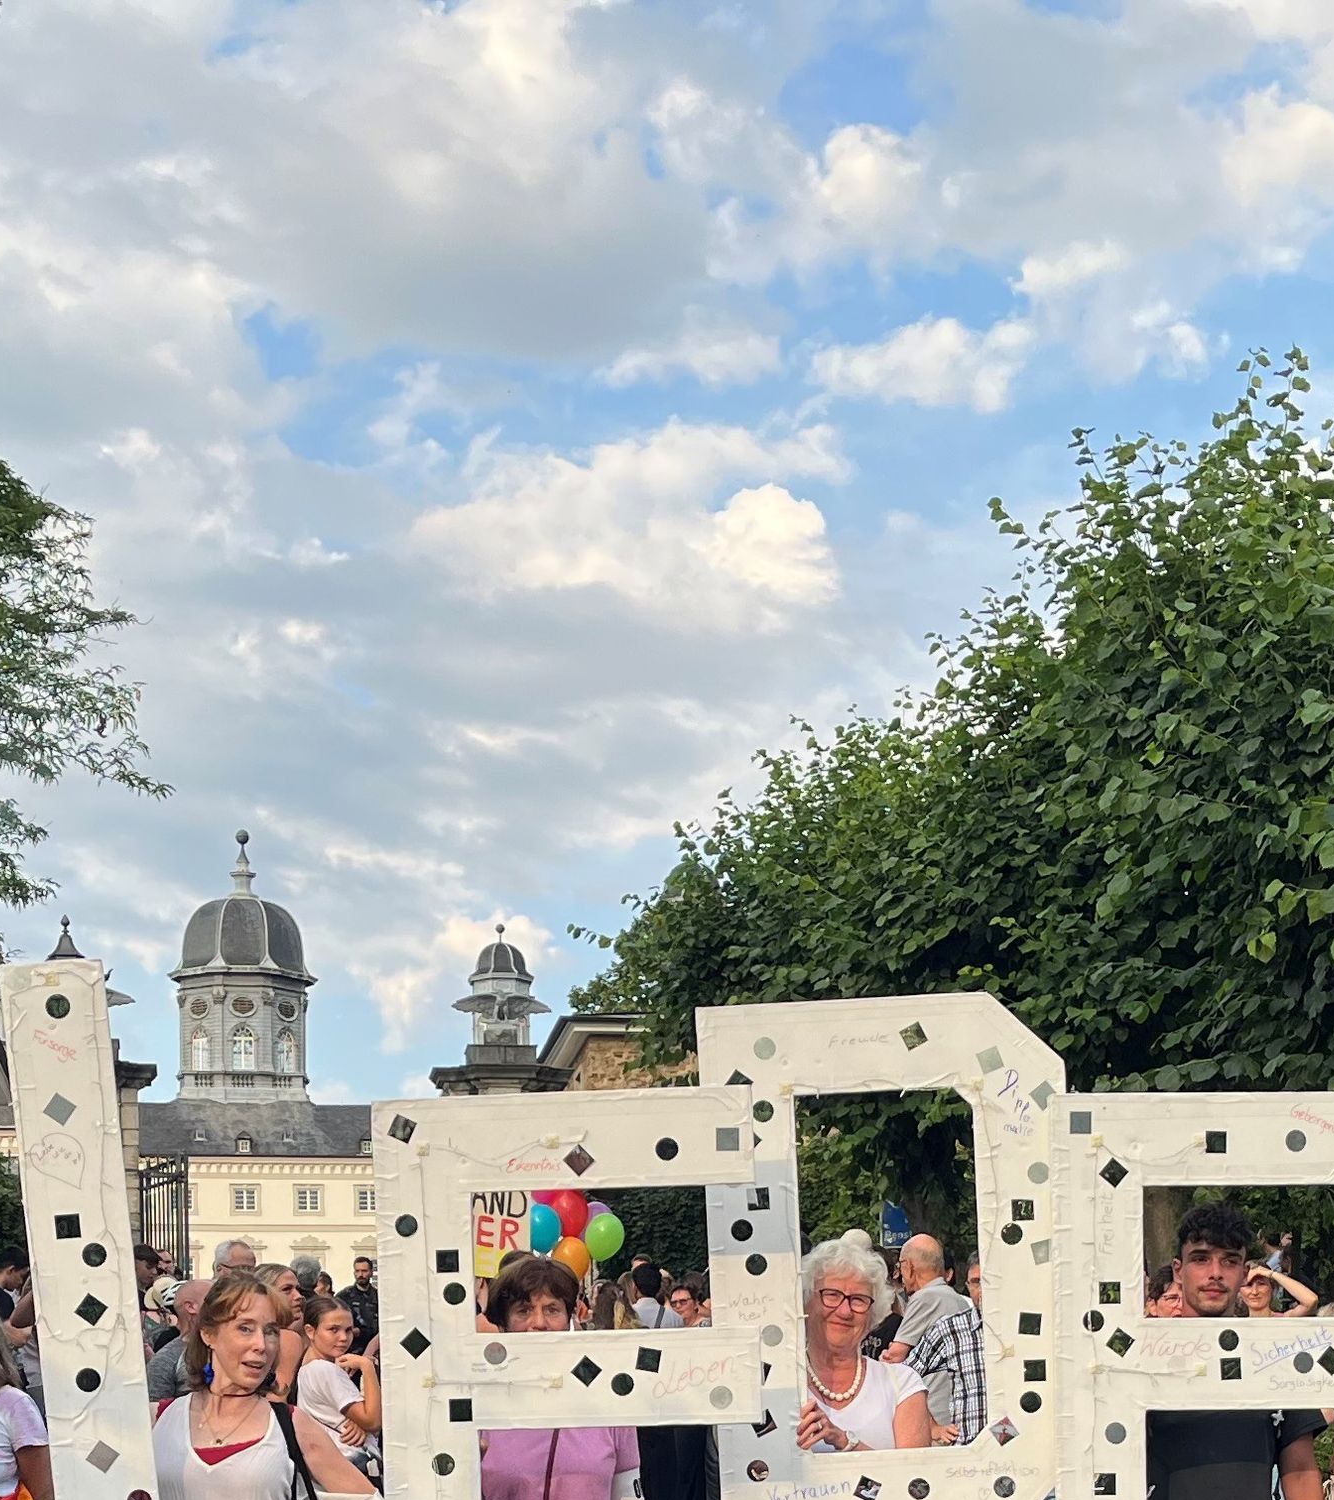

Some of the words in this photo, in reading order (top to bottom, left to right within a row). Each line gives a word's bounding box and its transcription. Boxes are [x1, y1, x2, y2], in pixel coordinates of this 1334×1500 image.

[1098, 1190, 1115, 1256] Freiheit
[1250, 1325, 1333, 1367] Sicherheit
[653, 1356, 736, 1399] Leben
